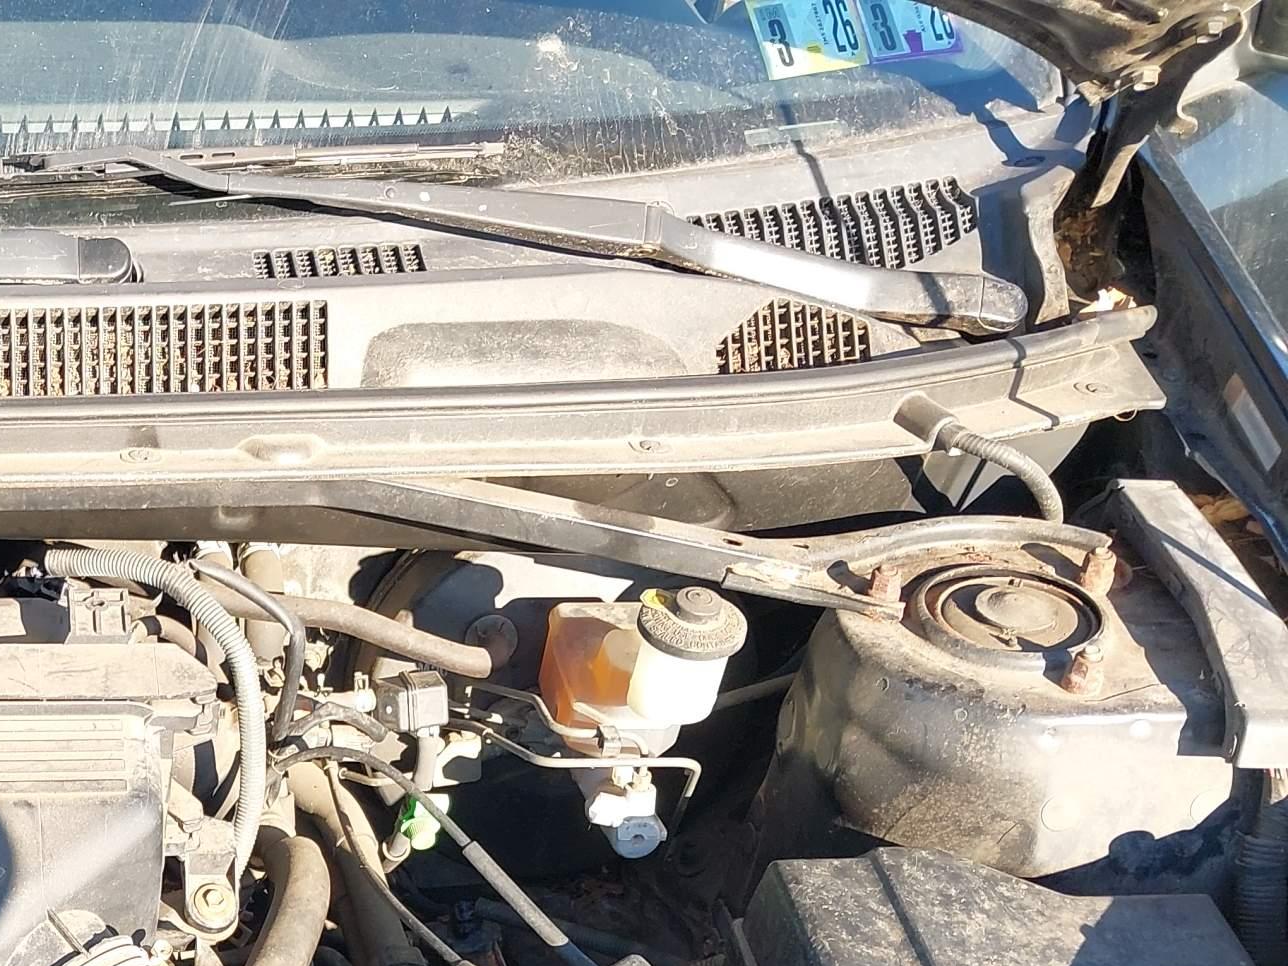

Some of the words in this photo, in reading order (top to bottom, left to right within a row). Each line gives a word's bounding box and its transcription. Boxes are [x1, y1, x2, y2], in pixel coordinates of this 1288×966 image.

[768, 19, 795, 67] 3
[822, 0, 859, 53] 26
[870, 3, 897, 51] 3
